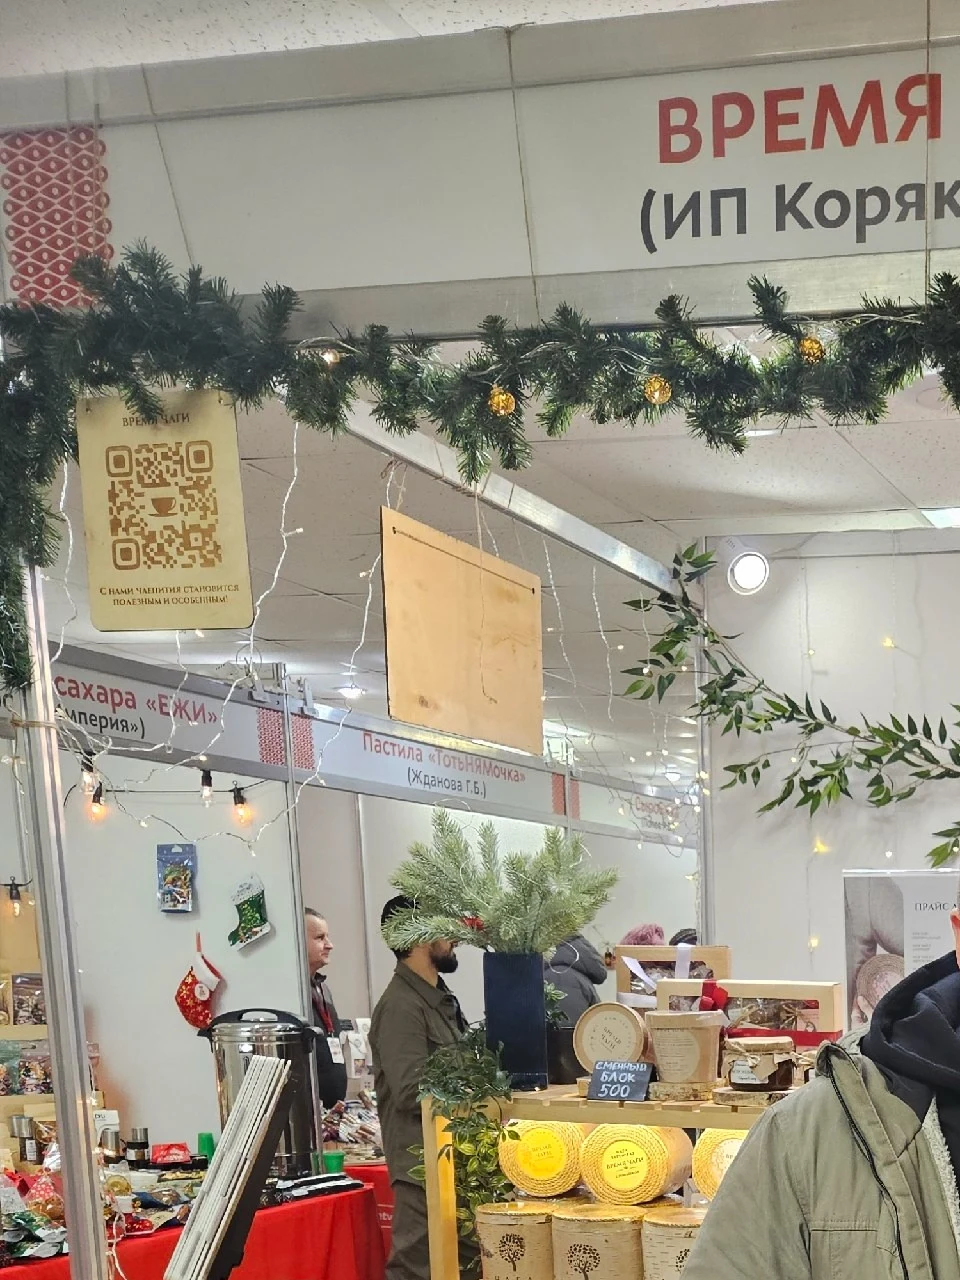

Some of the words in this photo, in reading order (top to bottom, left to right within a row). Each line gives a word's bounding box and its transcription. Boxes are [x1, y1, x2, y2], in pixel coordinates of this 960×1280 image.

[658, 73, 942, 164] ВРЕМЯ
[640, 186, 747, 254] (ИП
[163, 413, 191, 425] ЧАГИ
[53, 674, 137, 715] сахара
[363, 731, 423, 763] Пастила
[407, 766, 463, 792] (Жданова
[914, 901, 949, 912] ПРАЙС
[600, 1071, 636, 1083] БЛОК
[597, 1084, 631, 1098] 500
